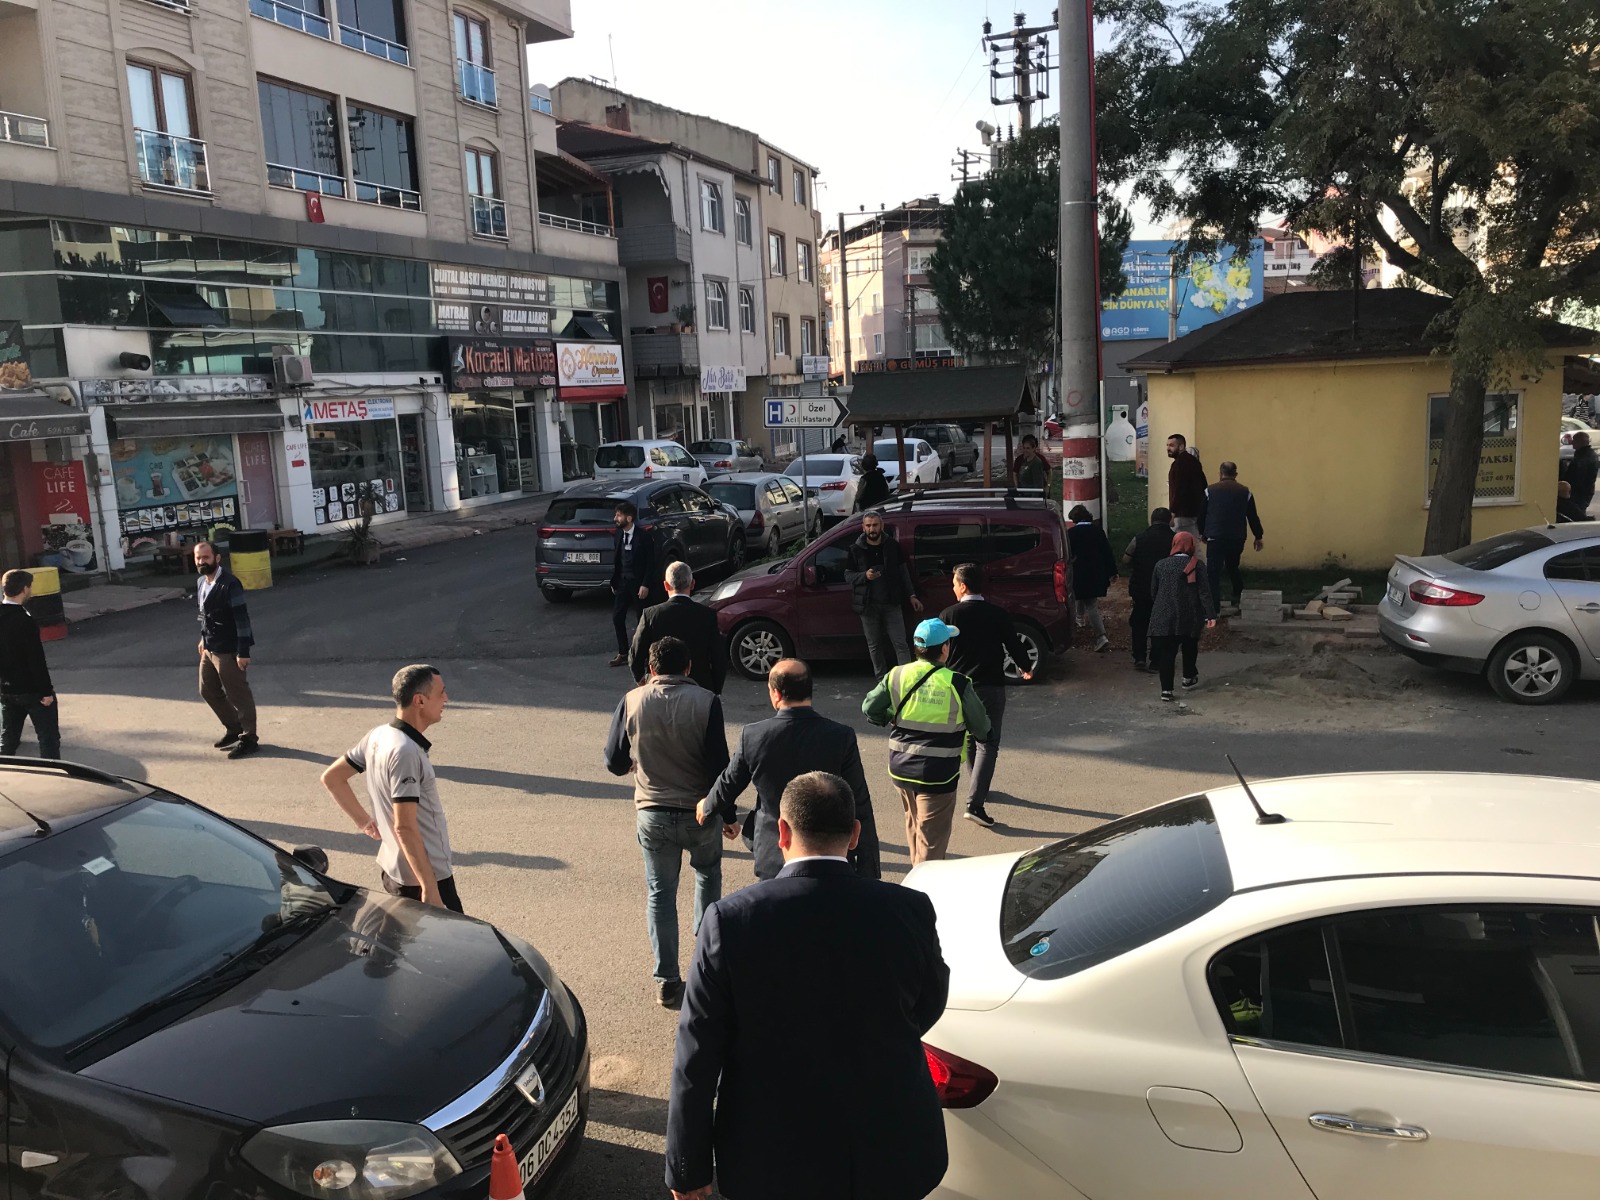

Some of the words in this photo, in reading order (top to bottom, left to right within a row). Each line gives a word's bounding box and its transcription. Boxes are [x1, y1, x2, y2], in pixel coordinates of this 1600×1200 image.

[1120, 299, 1154, 309] DÜNYA
[465, 346, 511, 373] Kocaeli
[313, 401, 367, 419] METAŞ
[808, 402, 826, 413] Özel
[9, 421, 40, 439] Cafe
[245, 454, 267, 466] LIFE
[43, 466, 76, 480] CAFE
[46, 481, 77, 493] LIFE
[538, 1130, 551, 1165] DC
[553, 1095, 577, 1142] 4352
